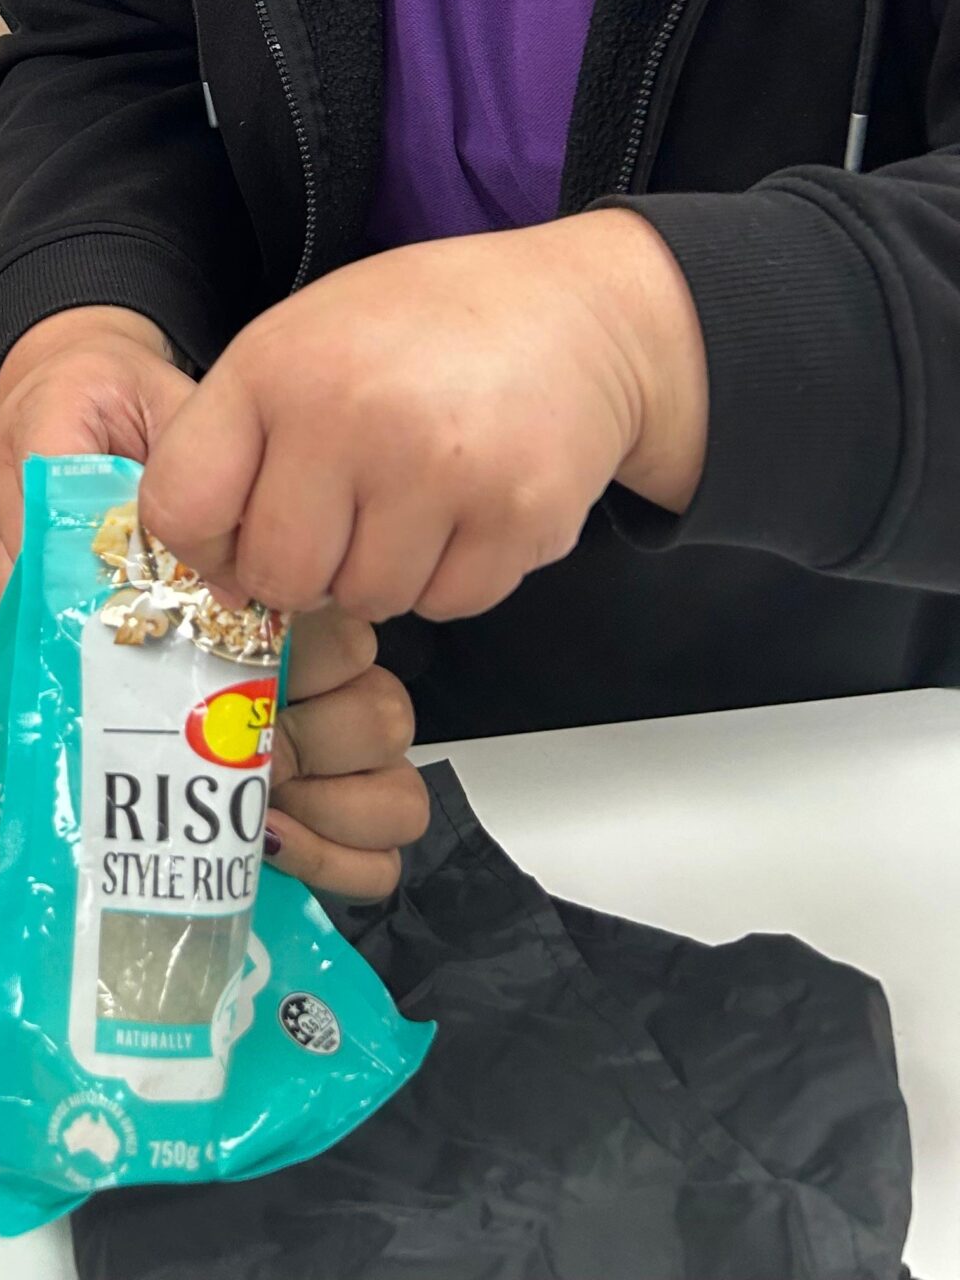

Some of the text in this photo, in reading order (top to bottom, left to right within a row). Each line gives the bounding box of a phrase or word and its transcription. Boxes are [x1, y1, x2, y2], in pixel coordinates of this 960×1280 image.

[104, 772, 267, 845] RISO
[102, 851, 255, 902] STYLE RICE
[116, 1029, 192, 1050] NATURALLY
[148, 1140, 200, 1172] 750g
